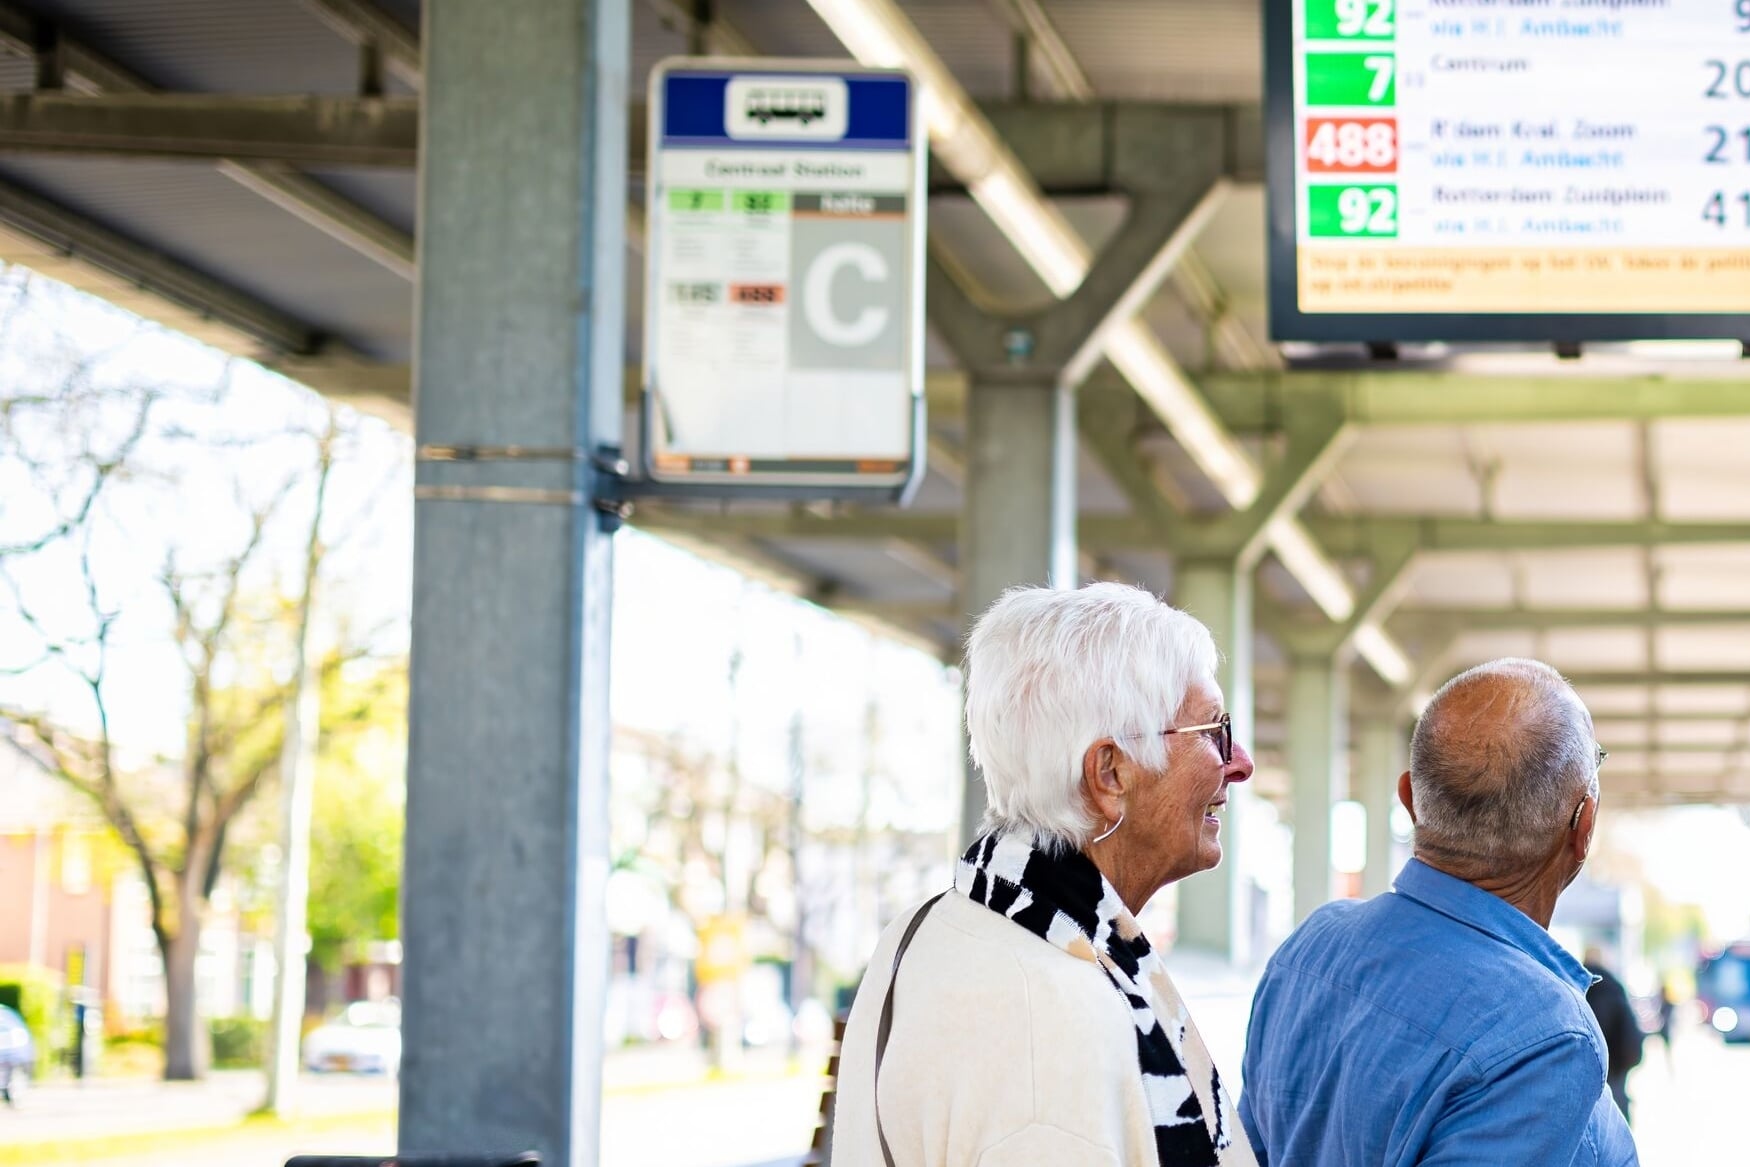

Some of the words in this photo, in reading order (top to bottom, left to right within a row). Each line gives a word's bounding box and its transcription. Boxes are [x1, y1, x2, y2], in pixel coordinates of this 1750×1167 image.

[1334, 0, 1395, 36] 92
[1363, 55, 1394, 103] 7
[1307, 121, 1396, 168] 488
[1336, 187, 1397, 234] 92
[803, 241, 890, 348] C
